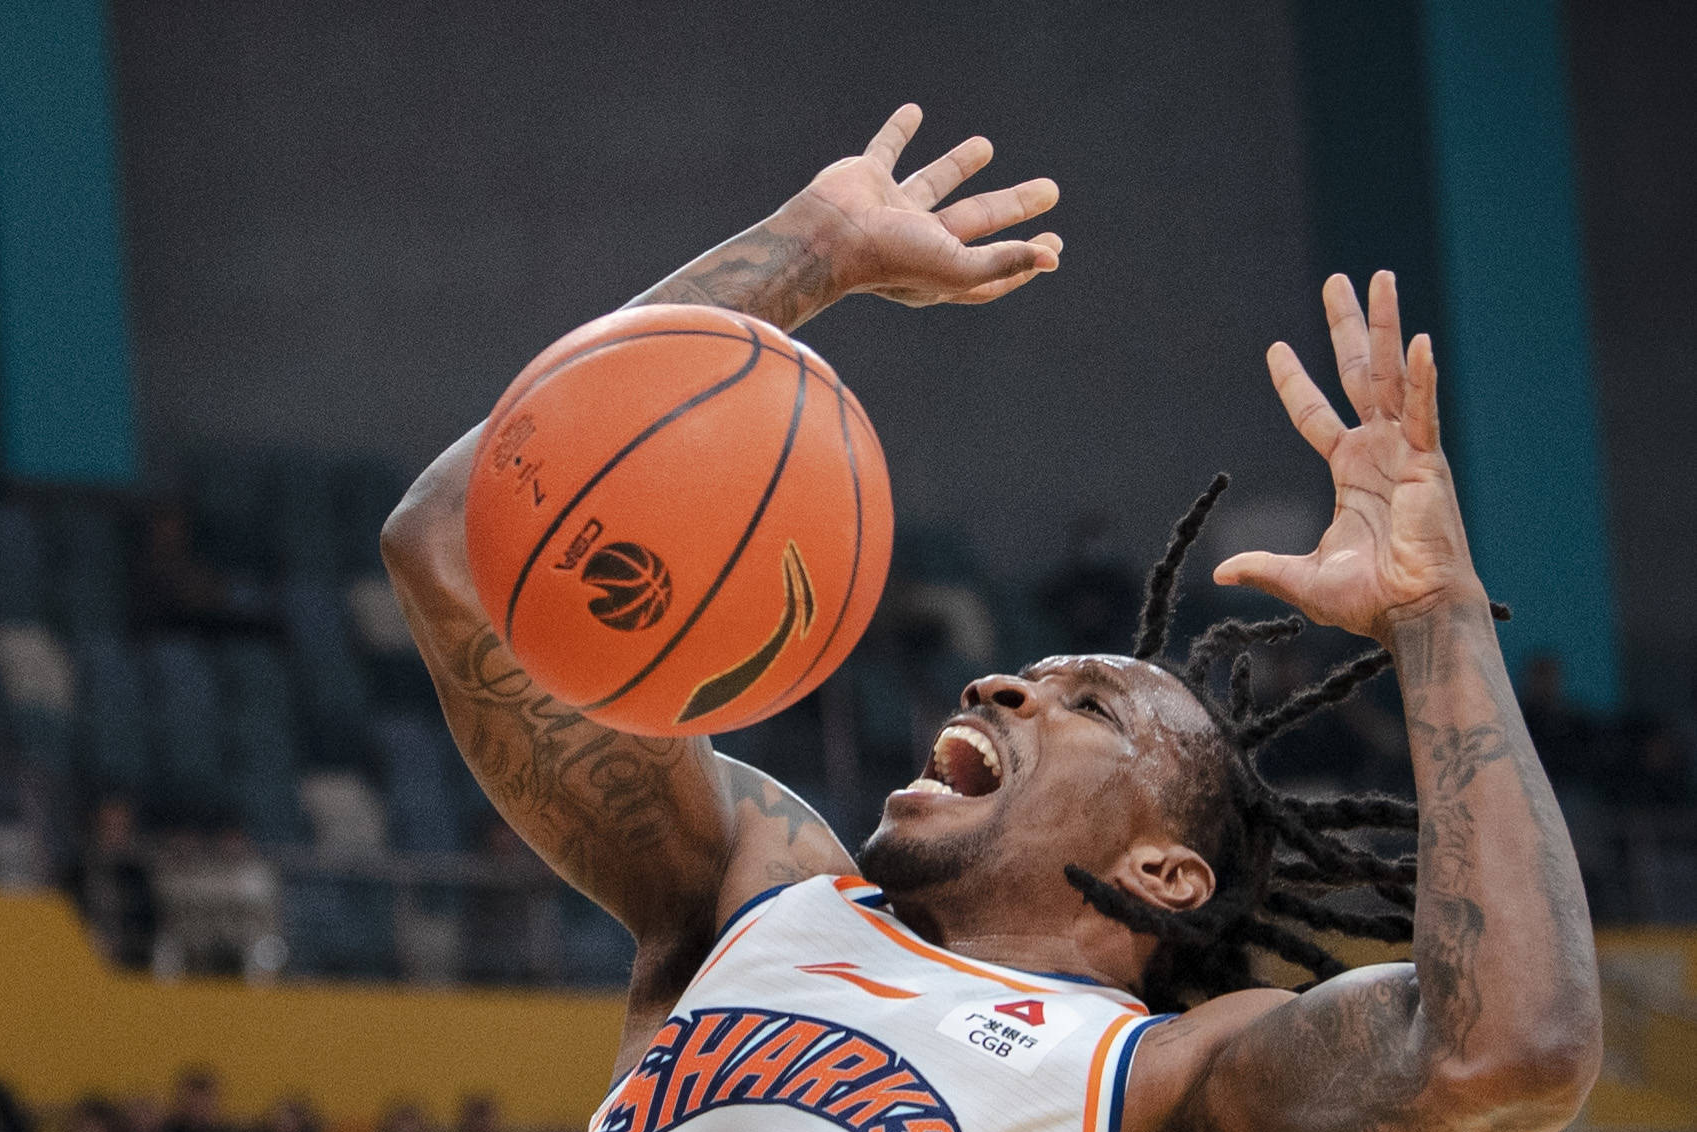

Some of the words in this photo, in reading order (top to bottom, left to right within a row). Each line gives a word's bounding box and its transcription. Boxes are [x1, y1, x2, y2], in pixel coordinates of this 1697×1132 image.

[555, 518, 603, 570] CBA
[965, 1012, 1039, 1049] 广发银行
[968, 1029, 1013, 1058] CGB
